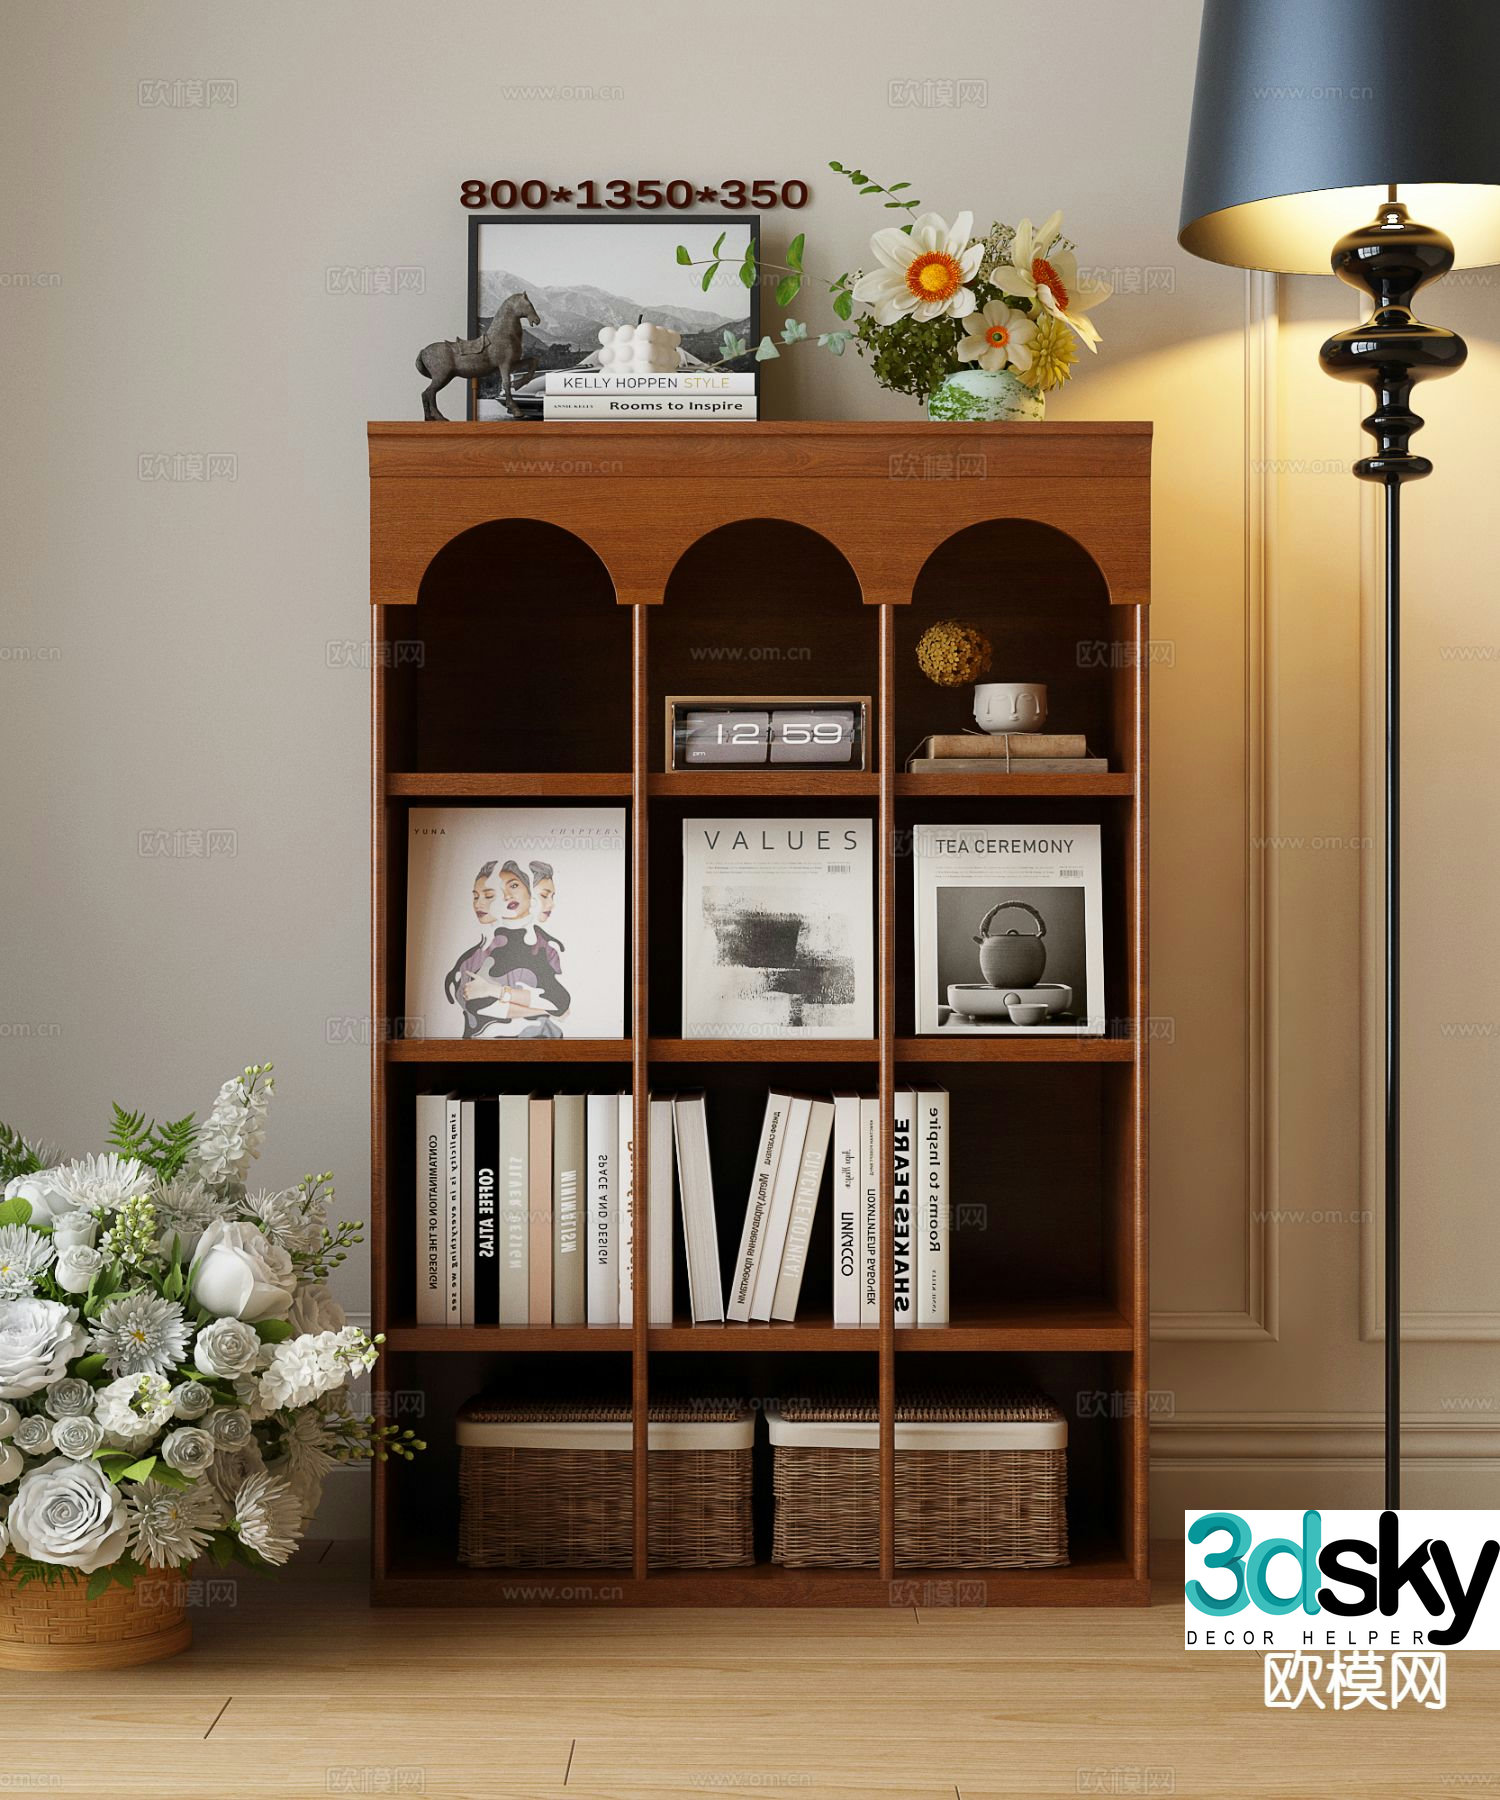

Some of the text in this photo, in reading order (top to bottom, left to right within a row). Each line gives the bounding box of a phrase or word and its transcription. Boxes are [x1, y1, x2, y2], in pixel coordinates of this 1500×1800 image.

[563, 377, 729, 389] KELLY HOPPEN STYLE
[609, 401, 743, 414] Rooms to Inspire
[717, 723, 843, 745] 12 59
[550, 827, 620, 835] CHAPTERS
[704, 830, 857, 850] VALUES
[936, 839, 1074, 854] TEA CEREMONY
